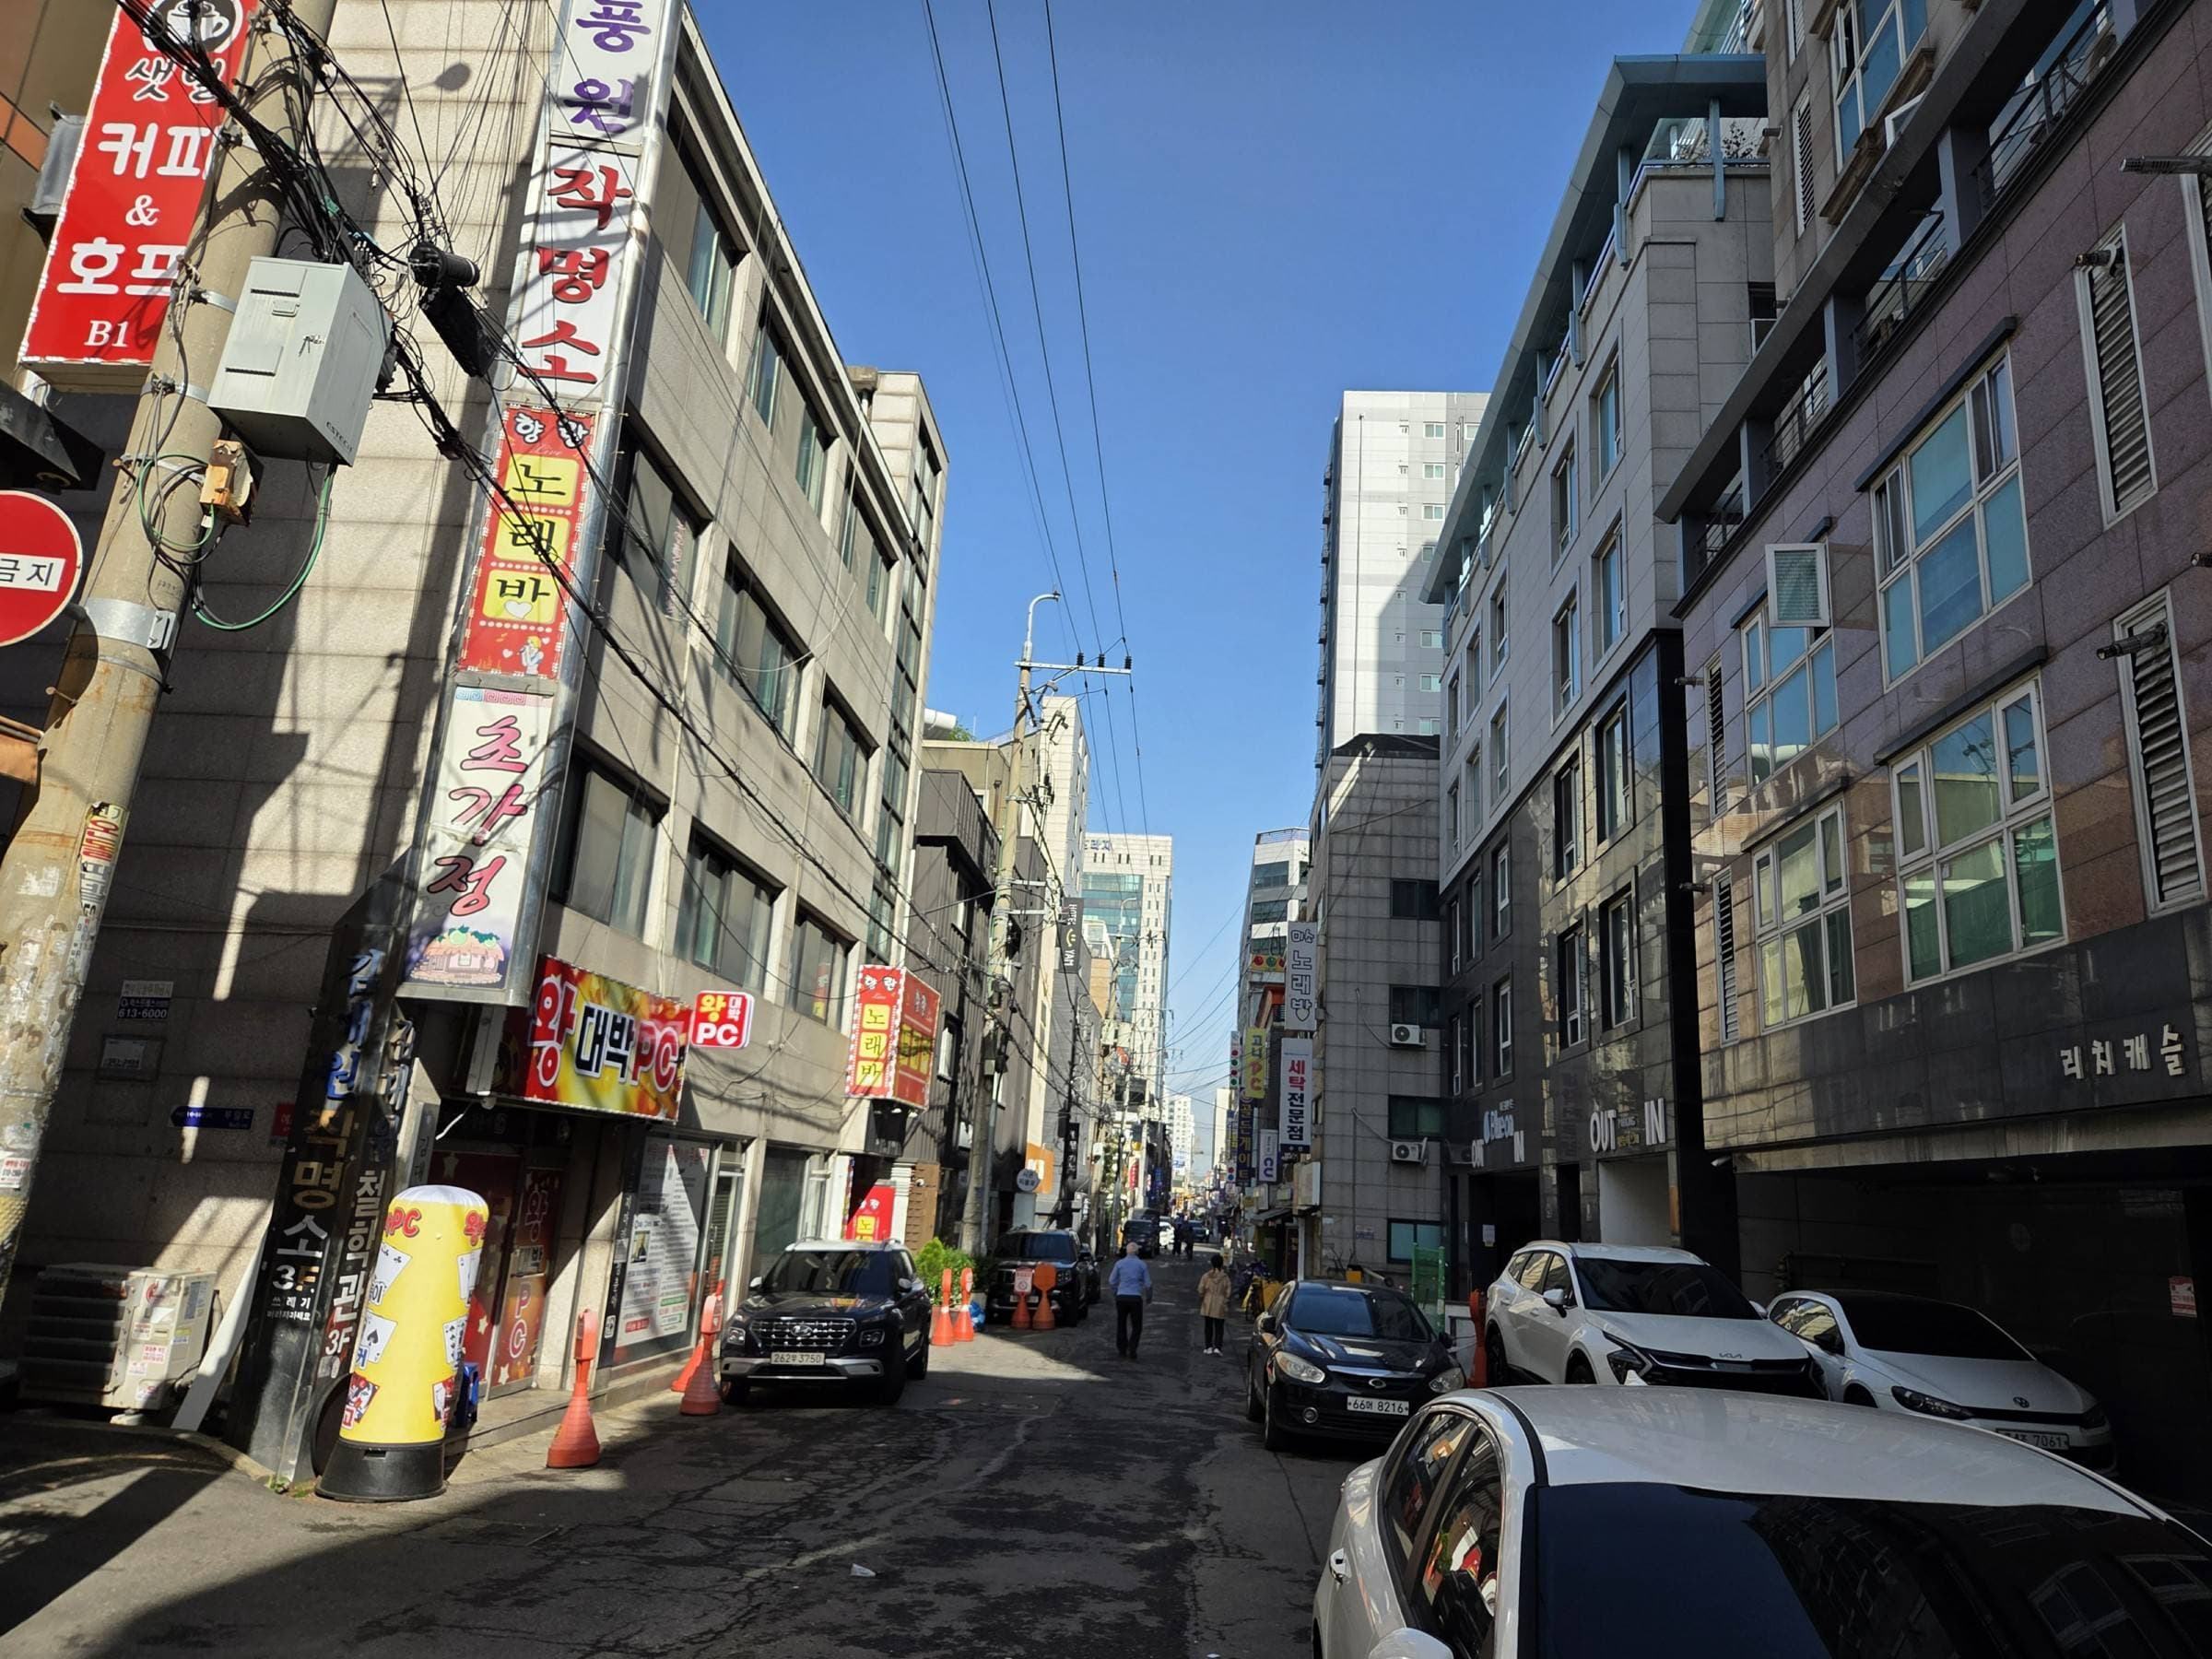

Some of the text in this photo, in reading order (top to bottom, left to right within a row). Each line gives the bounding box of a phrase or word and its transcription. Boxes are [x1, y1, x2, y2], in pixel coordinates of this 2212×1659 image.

[98, 123, 222, 180] 커피
[125, 194, 160, 227] &
[56, 237, 187, 297] 호프
[516, 165, 633, 383] 작명소
[83, 321, 129, 347] B1
[0, 559, 55, 586] 금지
[427, 715, 528, 916] 초가정
[1291, 929, 1315, 943] 미소
[695, 1022, 738, 1045] PC
[1590, 1097, 1666, 1152] OUT IN
[1377, 1400, 1404, 1414] 8216
[2032, 1434, 2063, 1448] 7061
